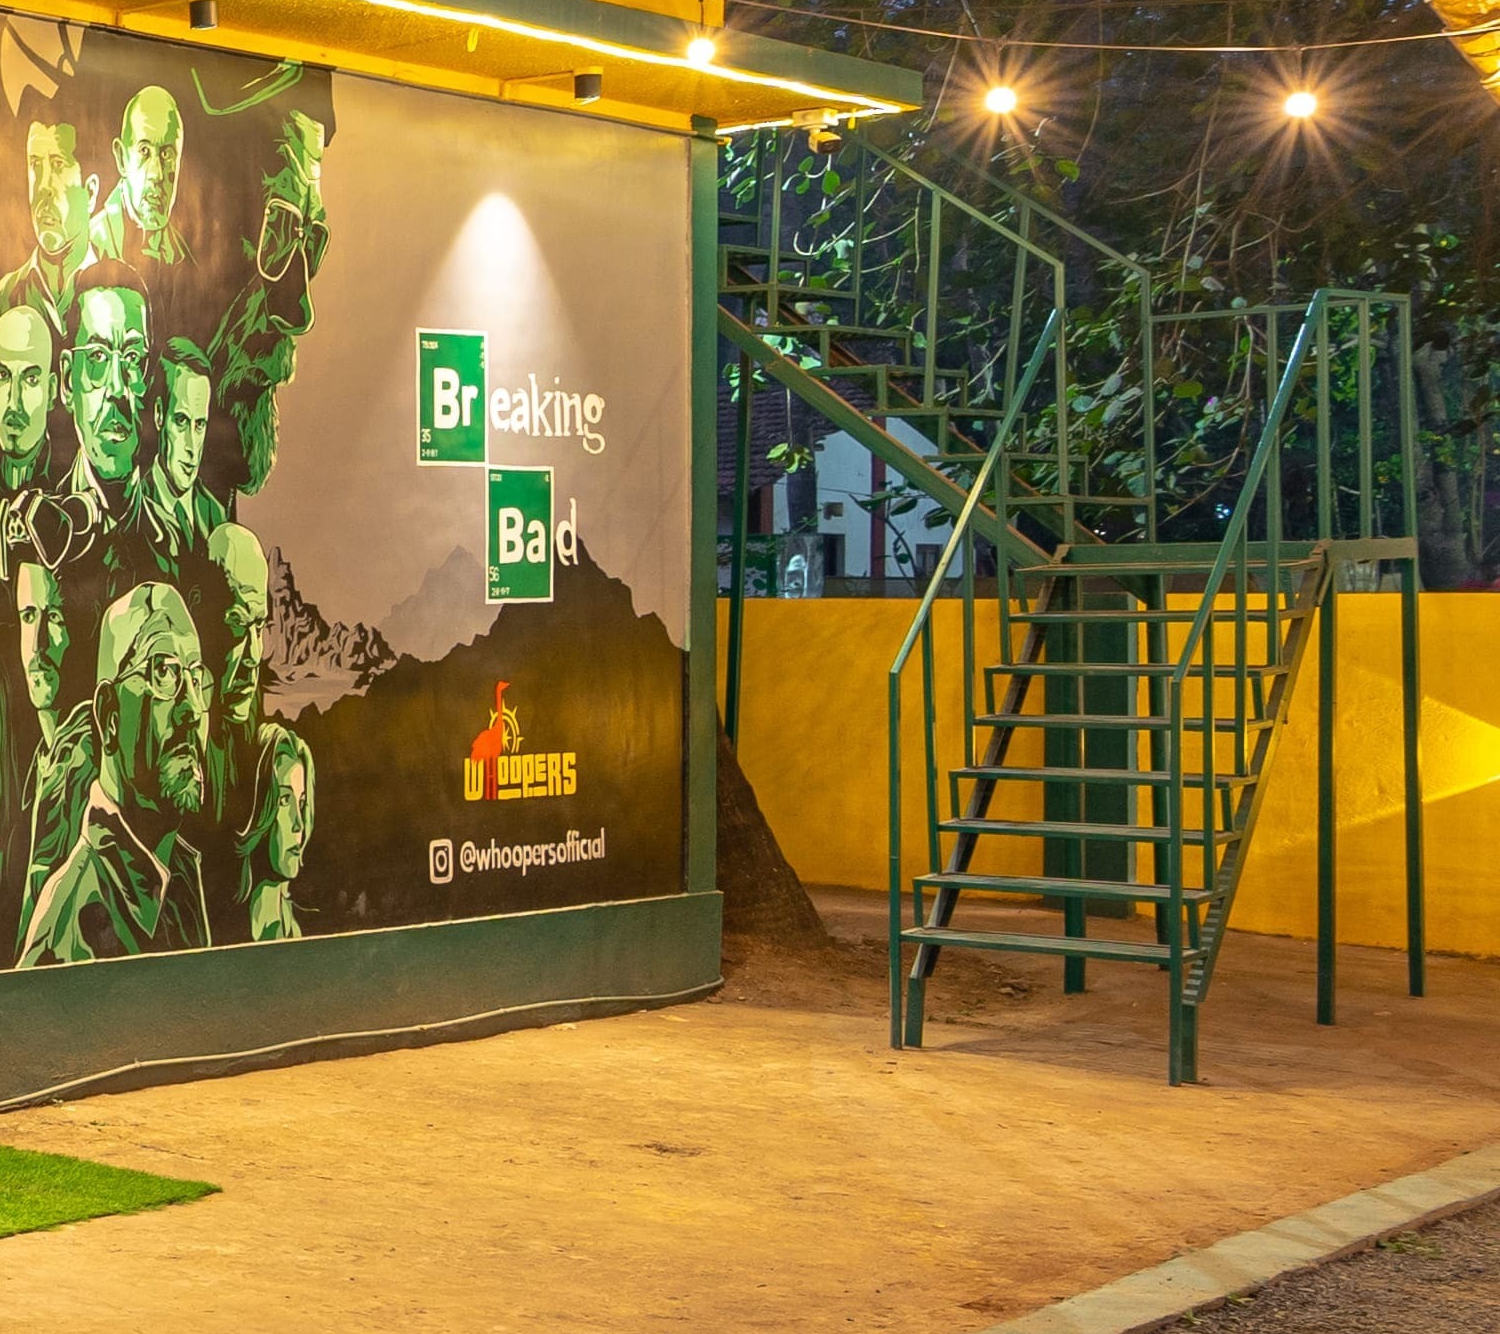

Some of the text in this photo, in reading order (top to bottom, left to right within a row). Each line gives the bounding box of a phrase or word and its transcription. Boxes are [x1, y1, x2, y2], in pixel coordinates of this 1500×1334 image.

[432, 367, 606, 455] Breaking
[498, 497, 579, 566] Bad
[463, 751, 577, 801] WHOOPERS
[459, 827, 606, 877] @whoopersofficial
